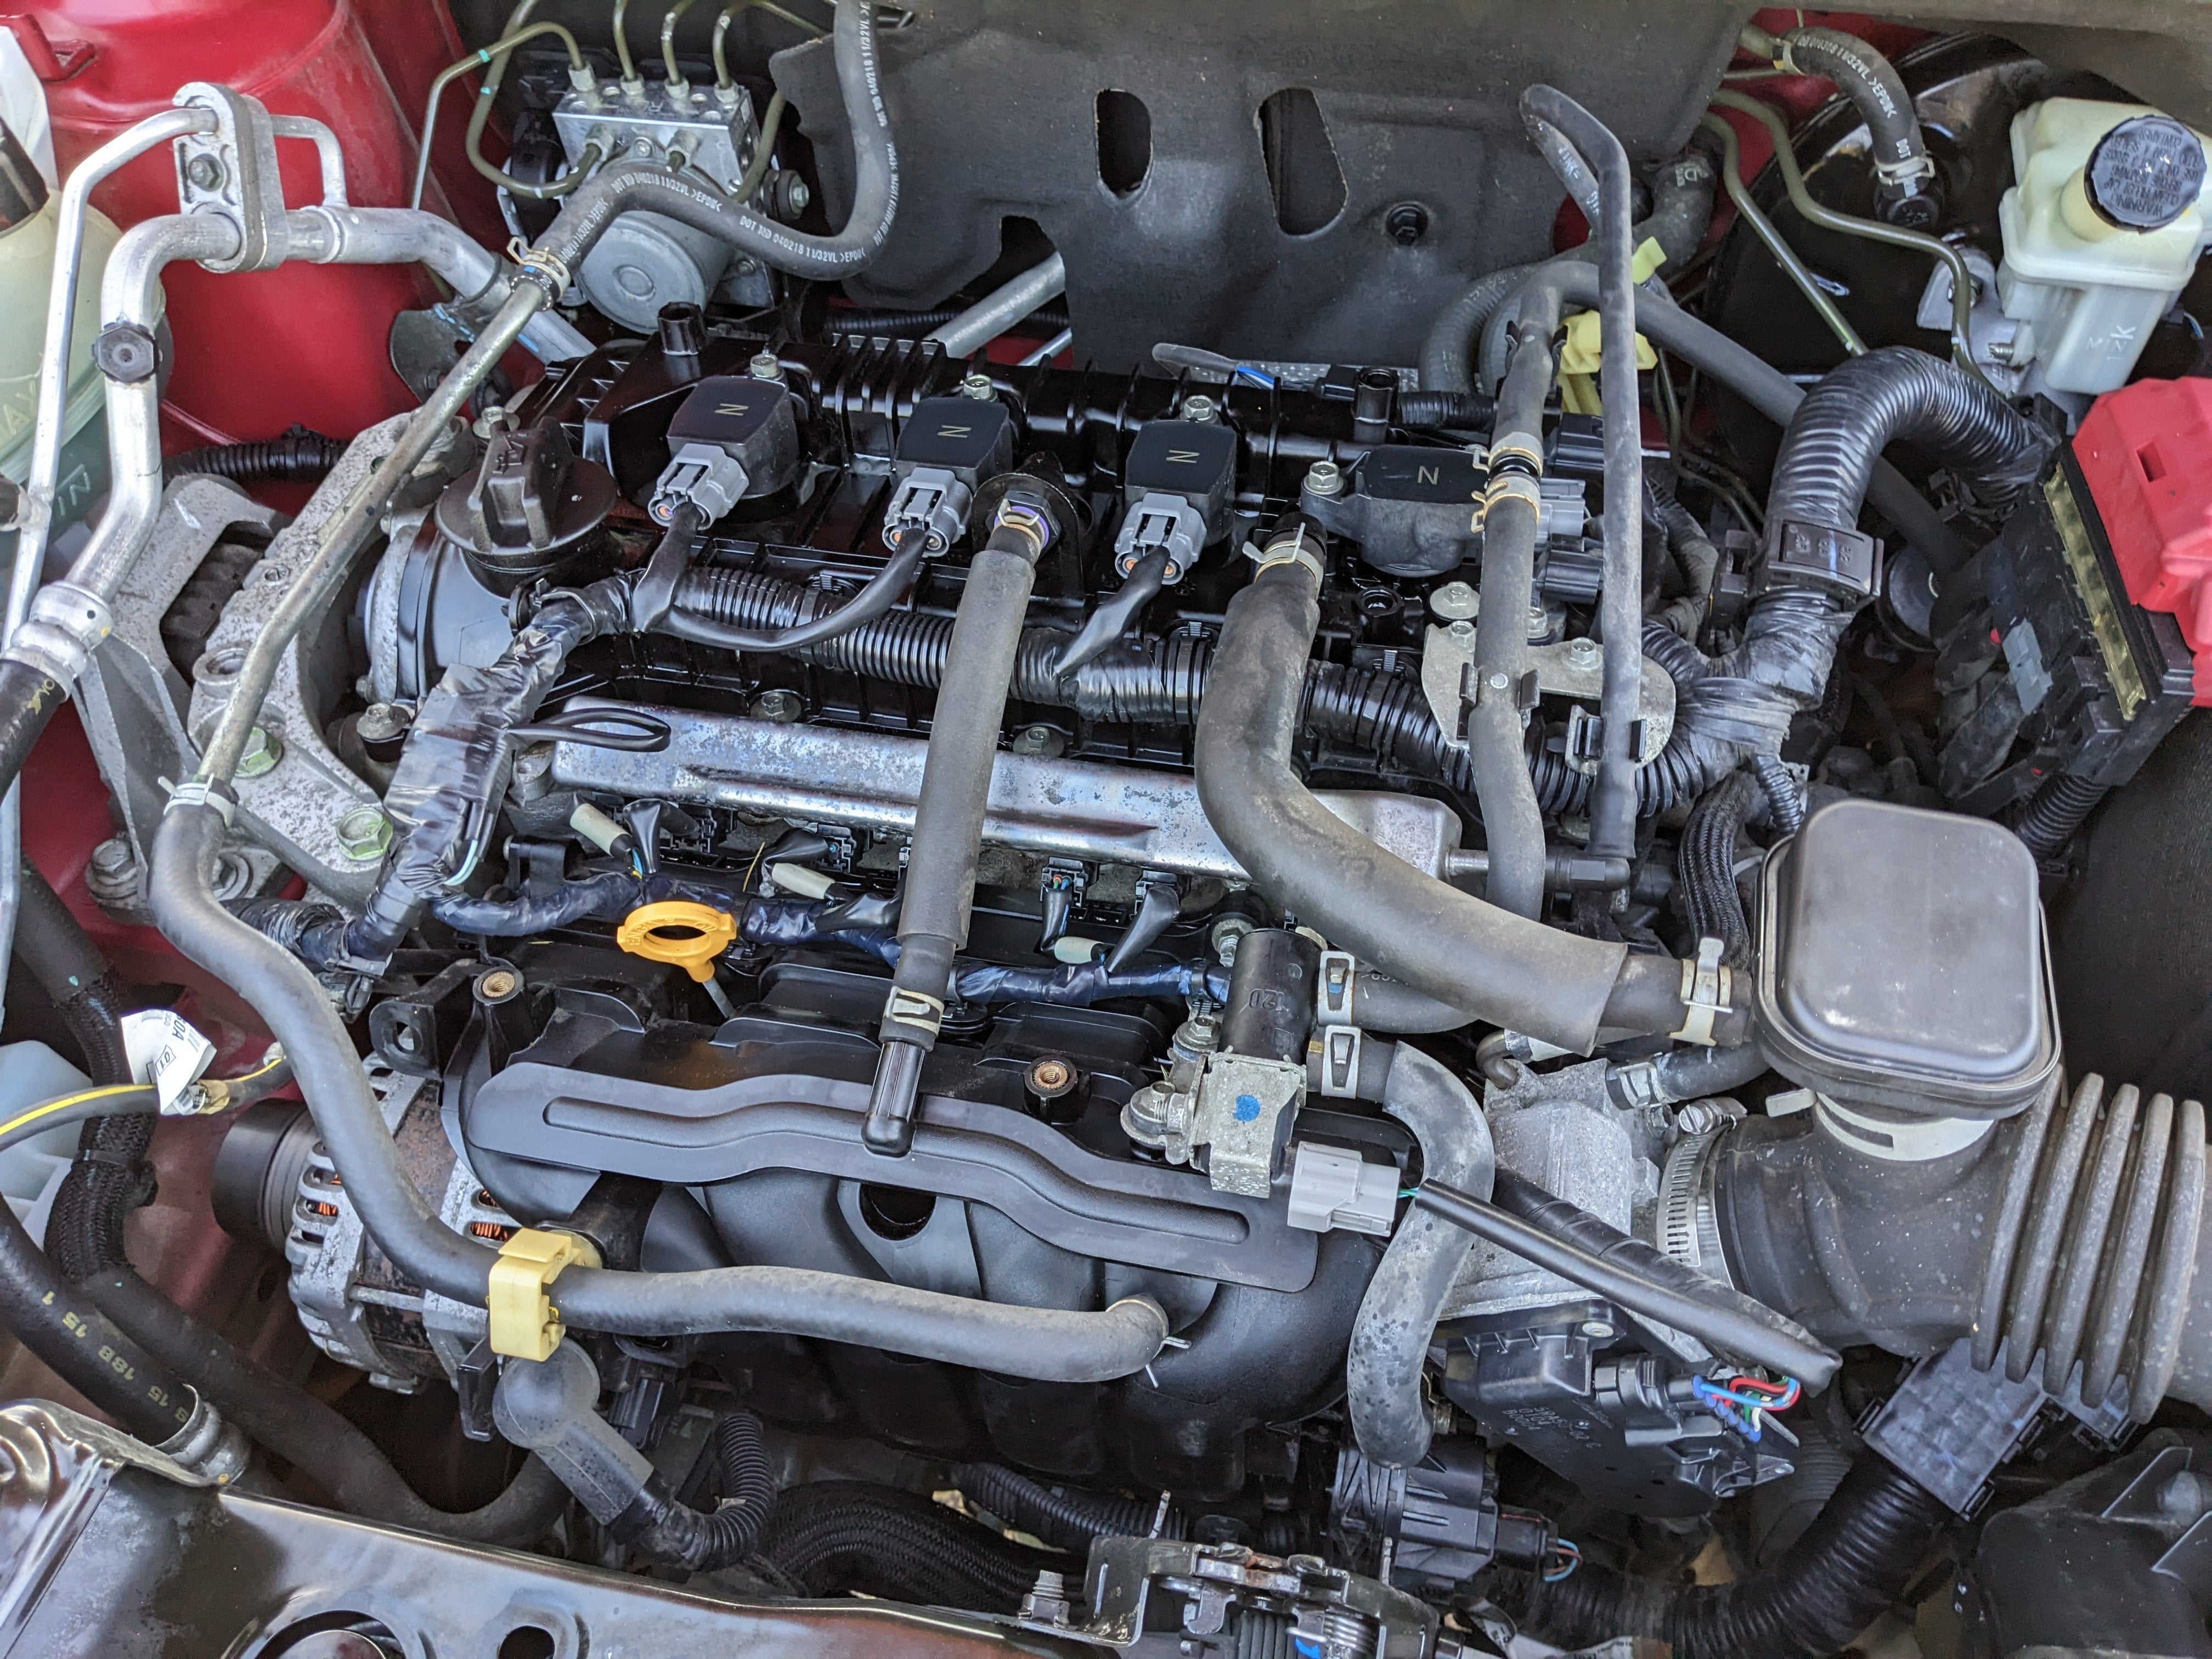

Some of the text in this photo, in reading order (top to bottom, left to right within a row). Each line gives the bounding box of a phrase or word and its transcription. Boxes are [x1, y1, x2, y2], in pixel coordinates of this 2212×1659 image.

[740, 215, 757, 230] DOT
[715, 403, 749, 416] N
[938, 426, 971, 437] N
[1166, 450, 1200, 463] N
[1418, 466, 1438, 484] N
[62, 1311, 87, 1338] 15
[148, 1385, 168, 1407] 15
